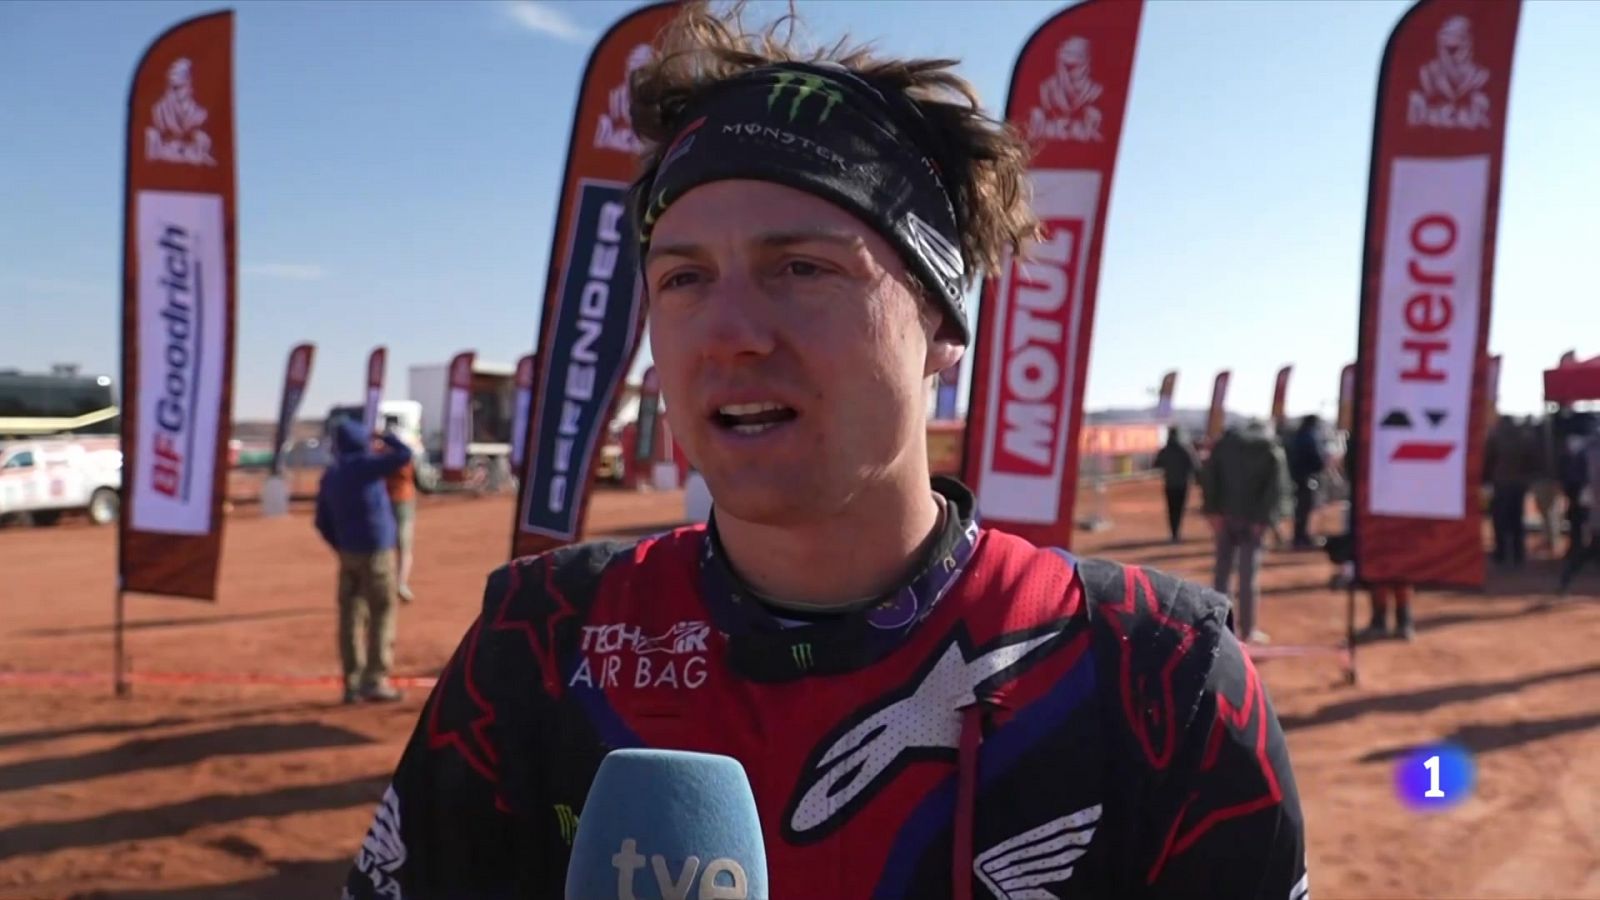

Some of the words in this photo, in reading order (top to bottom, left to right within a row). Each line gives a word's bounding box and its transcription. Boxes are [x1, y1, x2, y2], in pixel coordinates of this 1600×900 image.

[721, 123, 848, 172] MONSTER
[152, 223, 192, 498] BFGoodrich
[548, 201, 625, 513] DEFENDER
[1003, 226, 1075, 468] MOTUL
[1400, 213, 1458, 383] Hero
[568, 655, 622, 690] AIR
[633, 655, 708, 690] BAG
[611, 838, 748, 900] tve
